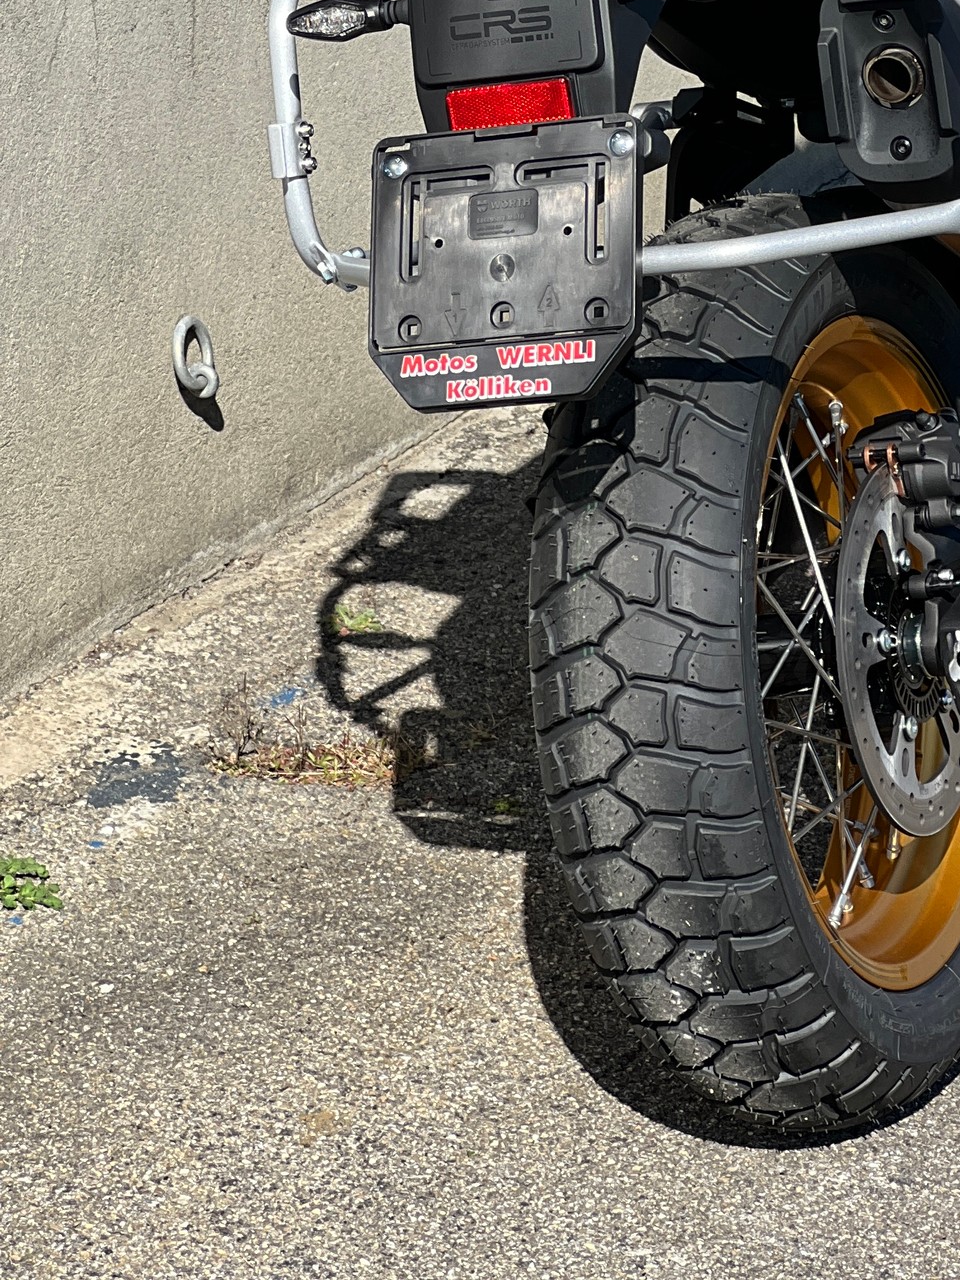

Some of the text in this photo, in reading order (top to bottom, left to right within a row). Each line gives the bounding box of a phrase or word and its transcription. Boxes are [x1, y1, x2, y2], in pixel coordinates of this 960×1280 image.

[449, 5, 552, 41] CRS
[400, 339, 596, 377] Motos WERNLI
[446, 375, 552, 402] Kölliken
